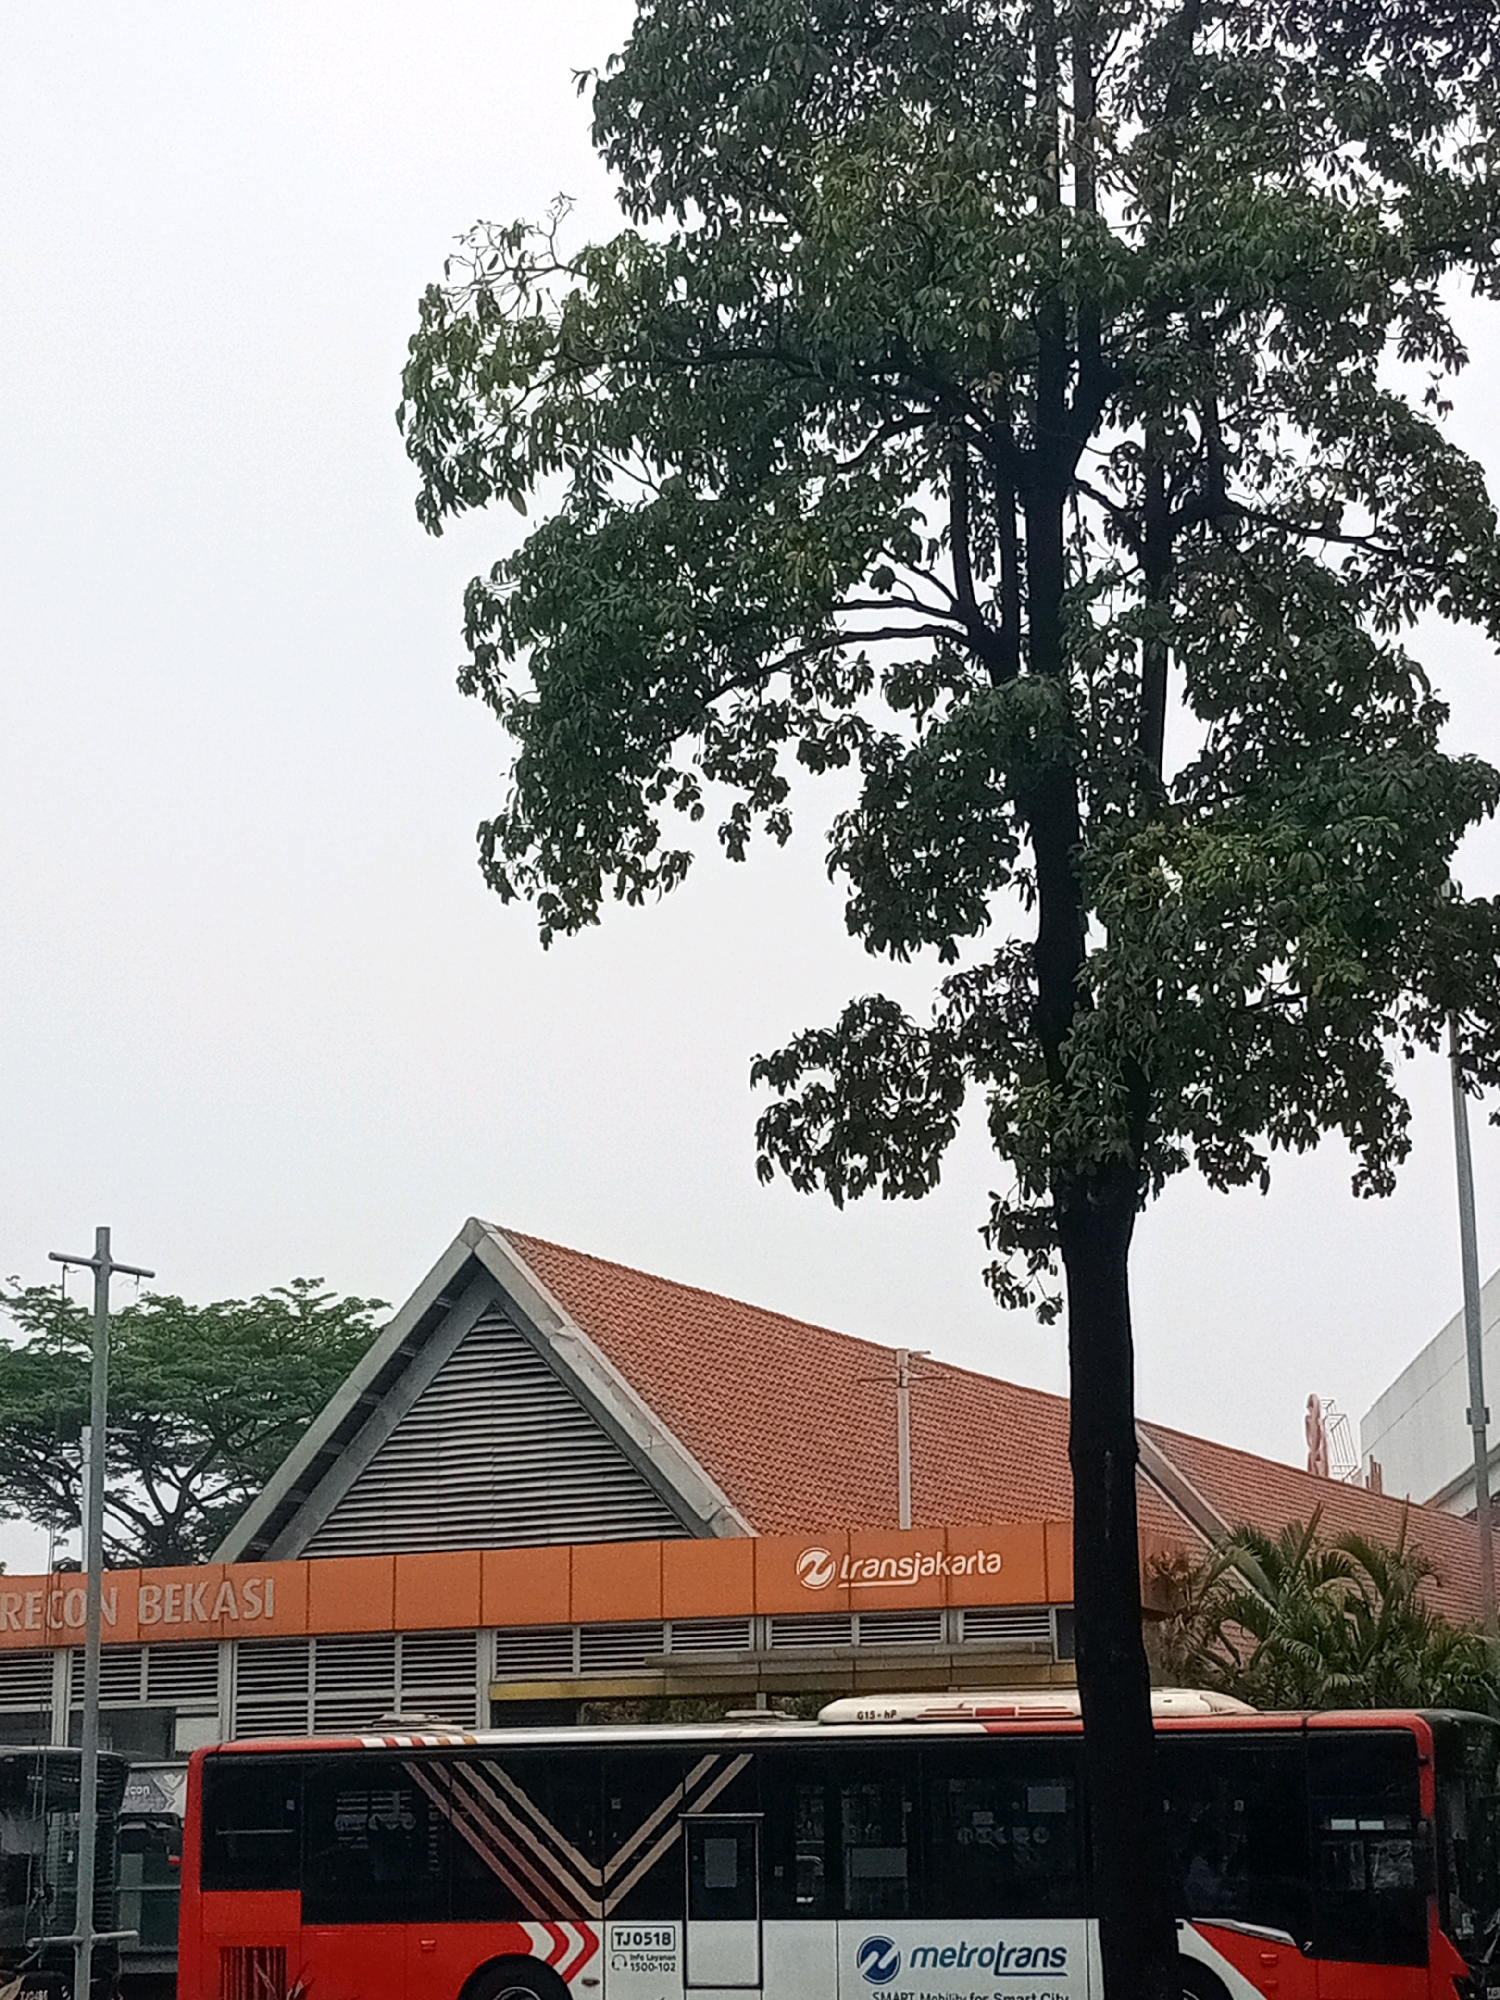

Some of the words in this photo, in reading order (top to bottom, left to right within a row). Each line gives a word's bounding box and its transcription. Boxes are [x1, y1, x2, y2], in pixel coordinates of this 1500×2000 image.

[837, 1550, 1001, 1588] transjakarta
[138, 1578, 274, 1625] BEKASI
[630, 1962, 676, 1972] 1500-102
[909, 1941, 1068, 1977] metrotrans
